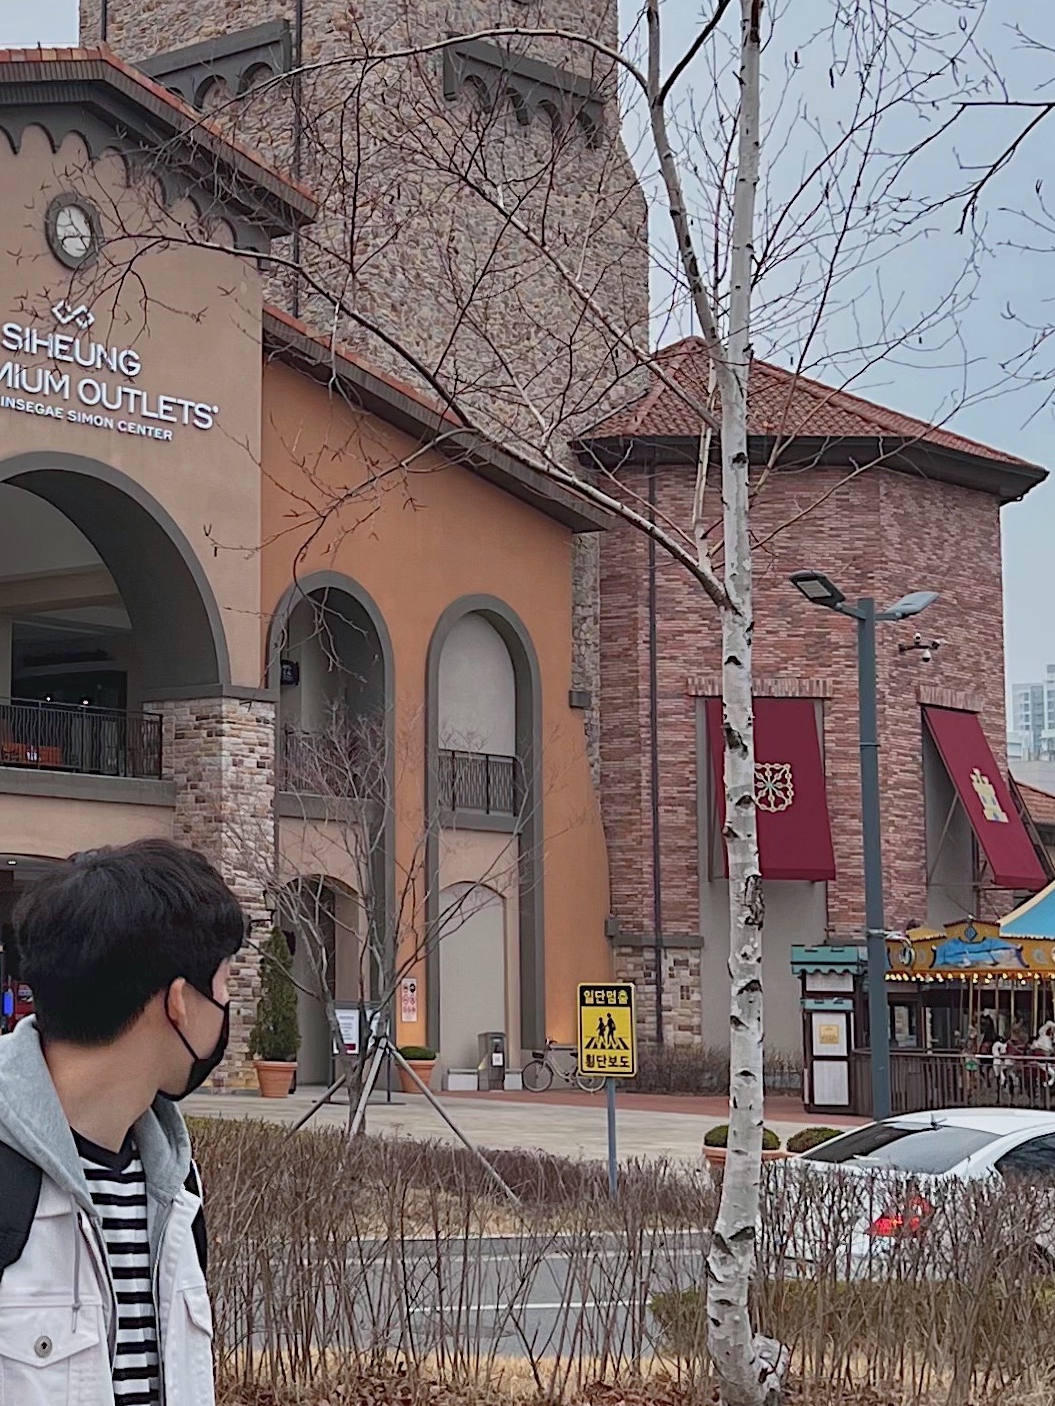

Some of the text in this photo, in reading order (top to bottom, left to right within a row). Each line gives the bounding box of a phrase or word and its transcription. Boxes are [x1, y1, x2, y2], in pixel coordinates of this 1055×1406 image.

[1, 322, 141, 376] SIHEUNG
[77, 378, 215, 430] OUTLETS
[67, 410, 114, 429] SIMON
[117, 420, 173, 442] CENTER
[586, 1054, 630, 1068] 횡단보도
